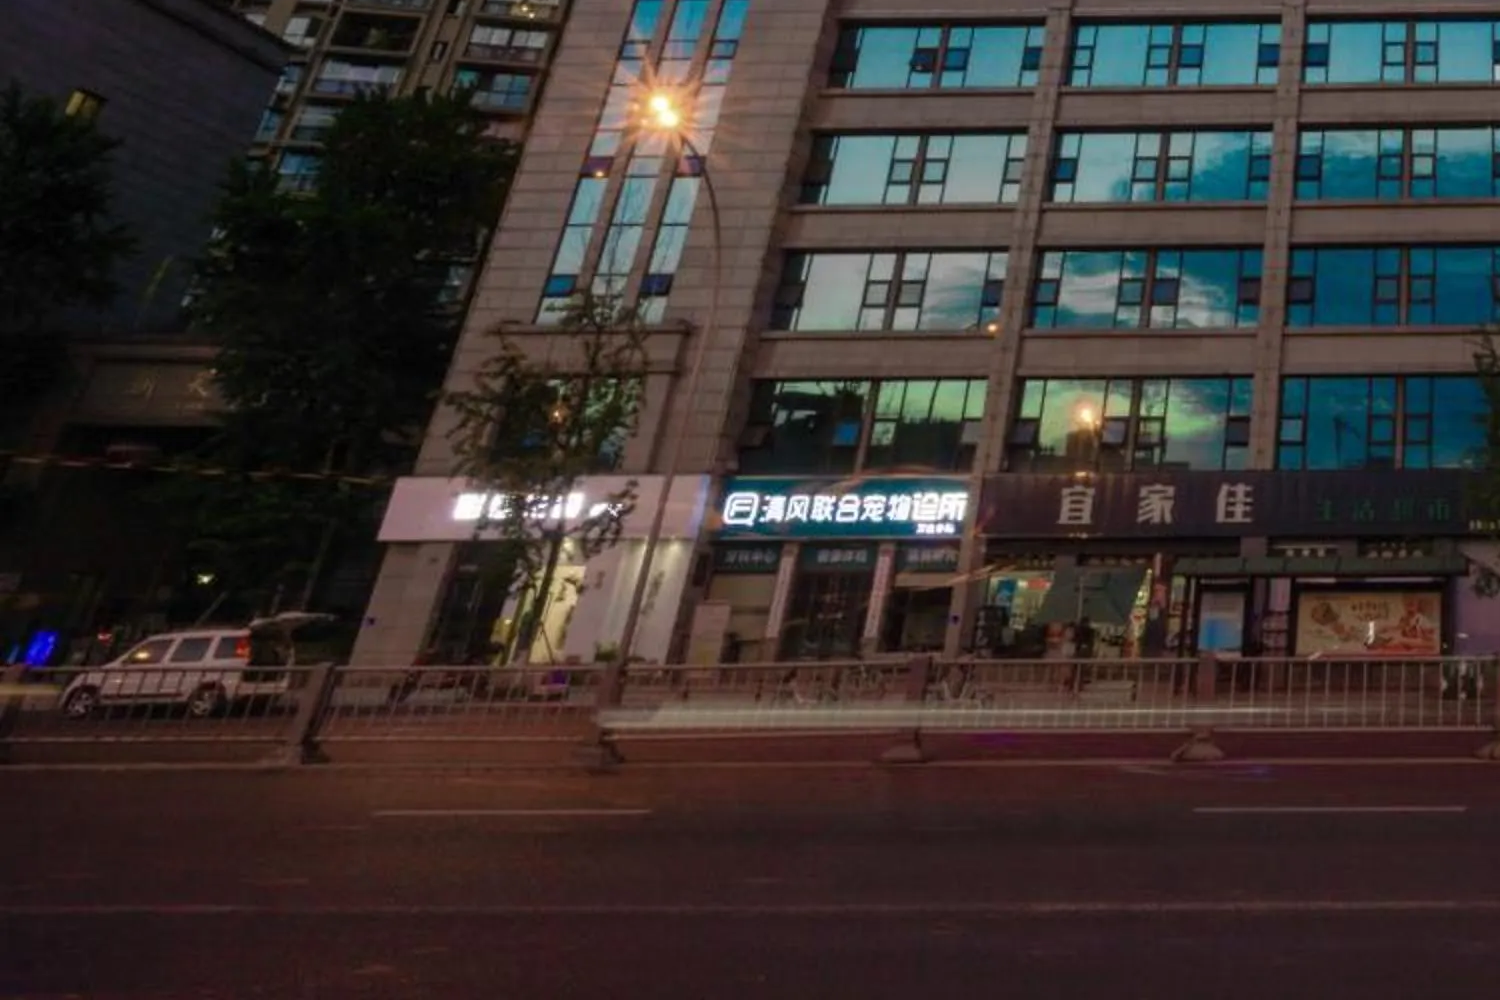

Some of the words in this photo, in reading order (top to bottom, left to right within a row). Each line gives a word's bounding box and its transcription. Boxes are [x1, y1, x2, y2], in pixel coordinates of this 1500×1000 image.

[759, 492, 969, 522] 清风联合宠物诊所
[1057, 483, 1254, 525] 宜家佳
